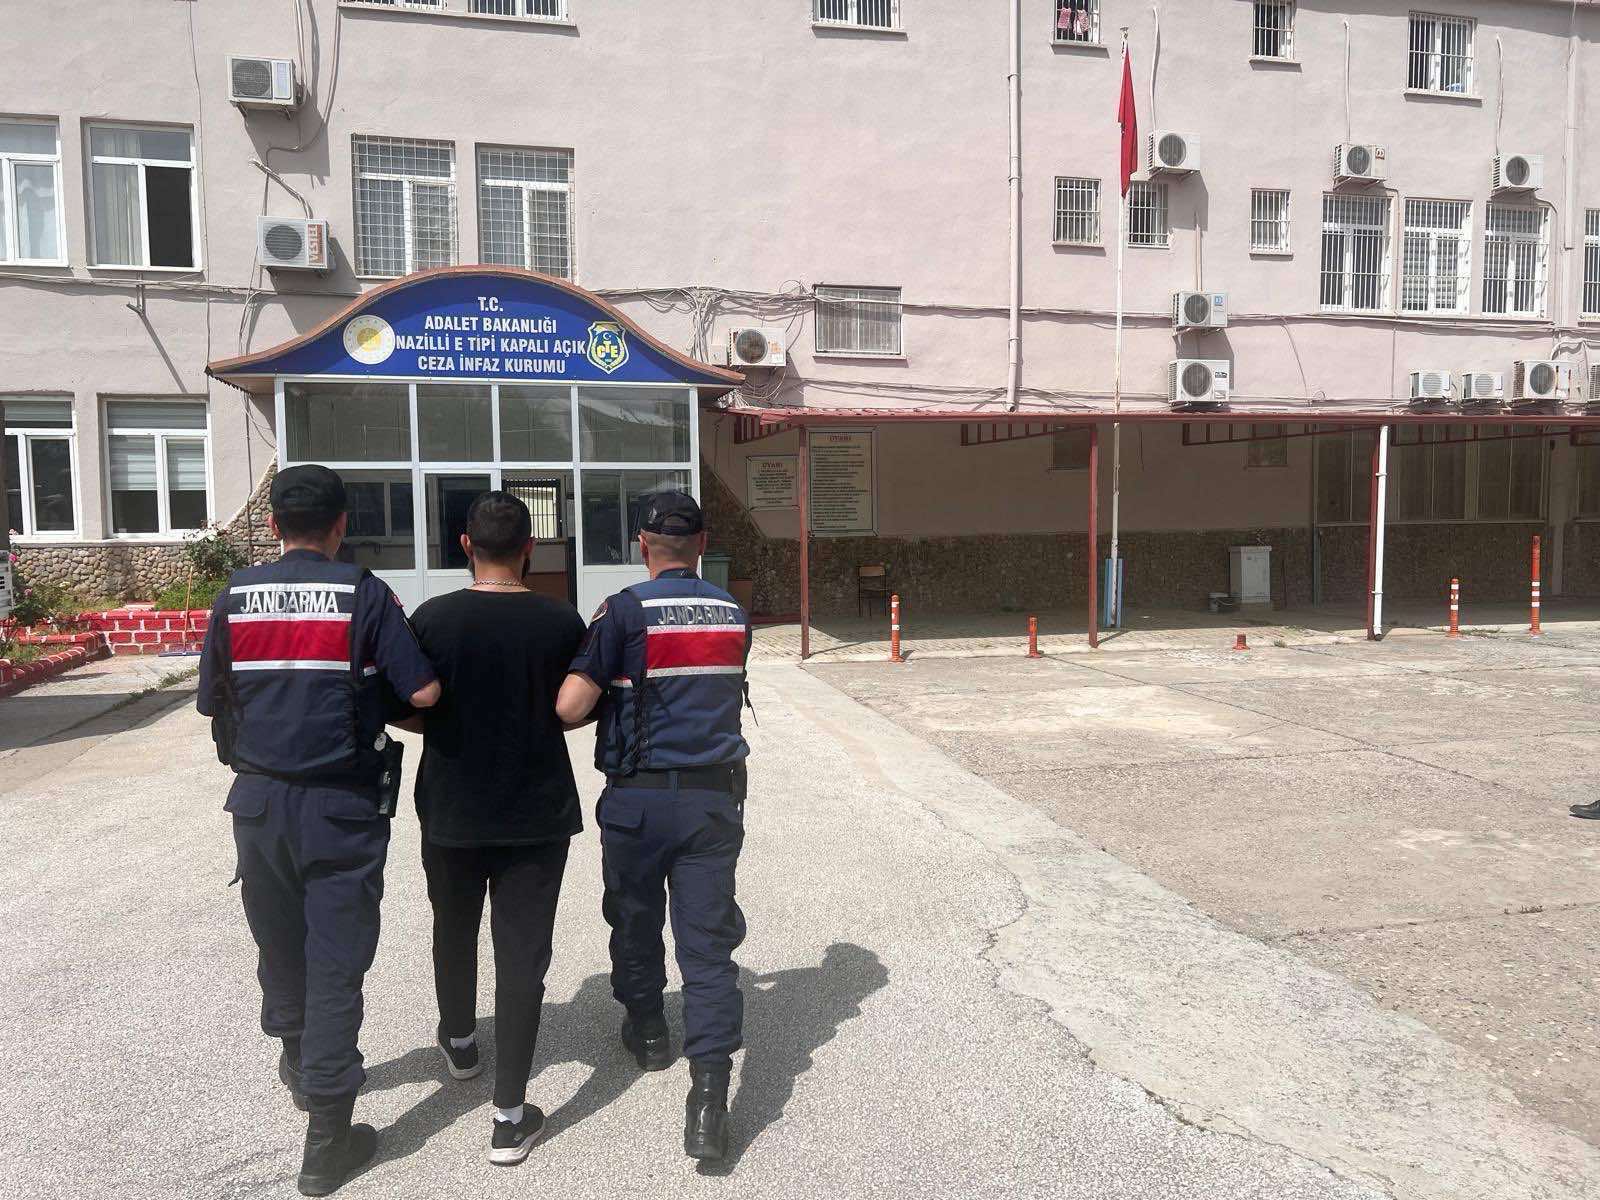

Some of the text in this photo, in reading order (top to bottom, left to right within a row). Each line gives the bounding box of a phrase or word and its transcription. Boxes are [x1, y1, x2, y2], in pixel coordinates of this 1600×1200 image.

[477, 296, 504, 312] T.C.
[424, 315, 557, 334] ADALET BAKANLIĞI
[396, 333, 586, 357] NAZİLLİ E TİPİ KAPALI AÇIK
[418, 353, 566, 374] CEZA İNFAZ KURUMU
[240, 592, 339, 613] JANDARMA
[658, 605, 737, 624] JANDARMA
